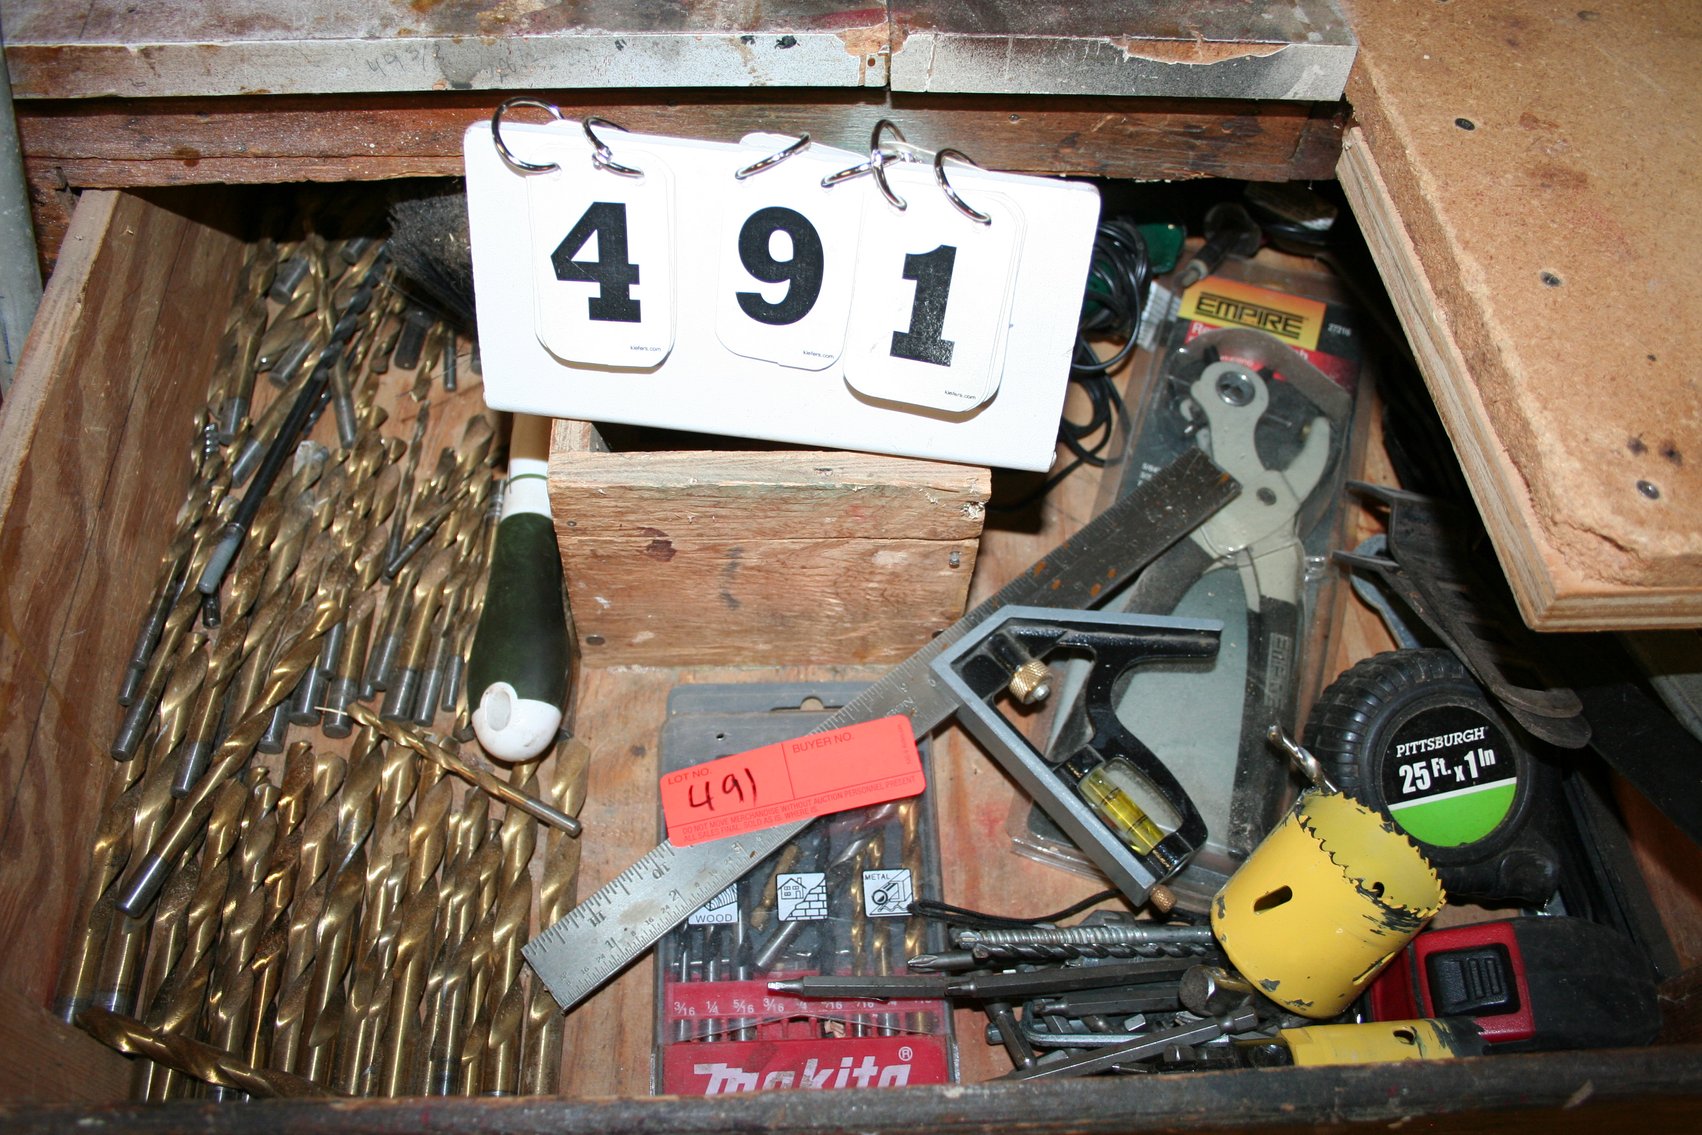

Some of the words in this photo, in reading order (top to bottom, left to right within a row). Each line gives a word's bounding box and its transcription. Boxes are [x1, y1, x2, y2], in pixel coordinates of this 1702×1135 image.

[550, 202, 642, 323] 4
[735, 206, 824, 325] 9
[889, 244, 957, 367] 1
[1195, 291, 1304, 340] EMPIRE
[792, 738, 832, 754] BUYER
[1396, 726, 1486, 758] PITTSBURGH
[667, 772, 690, 785] LOT
[692, 767, 713, 779] NO.
[1398, 761, 1431, 794] 25
[1430, 757, 1452, 778] Ft.
[1453, 765, 1466, 782] x
[1464, 750, 1479, 778] 1
[1477, 748, 1497, 768] In
[688, 767, 757, 812] 491
[682, 826, 694, 835] DO
[695, 914, 733, 922] WOOD
